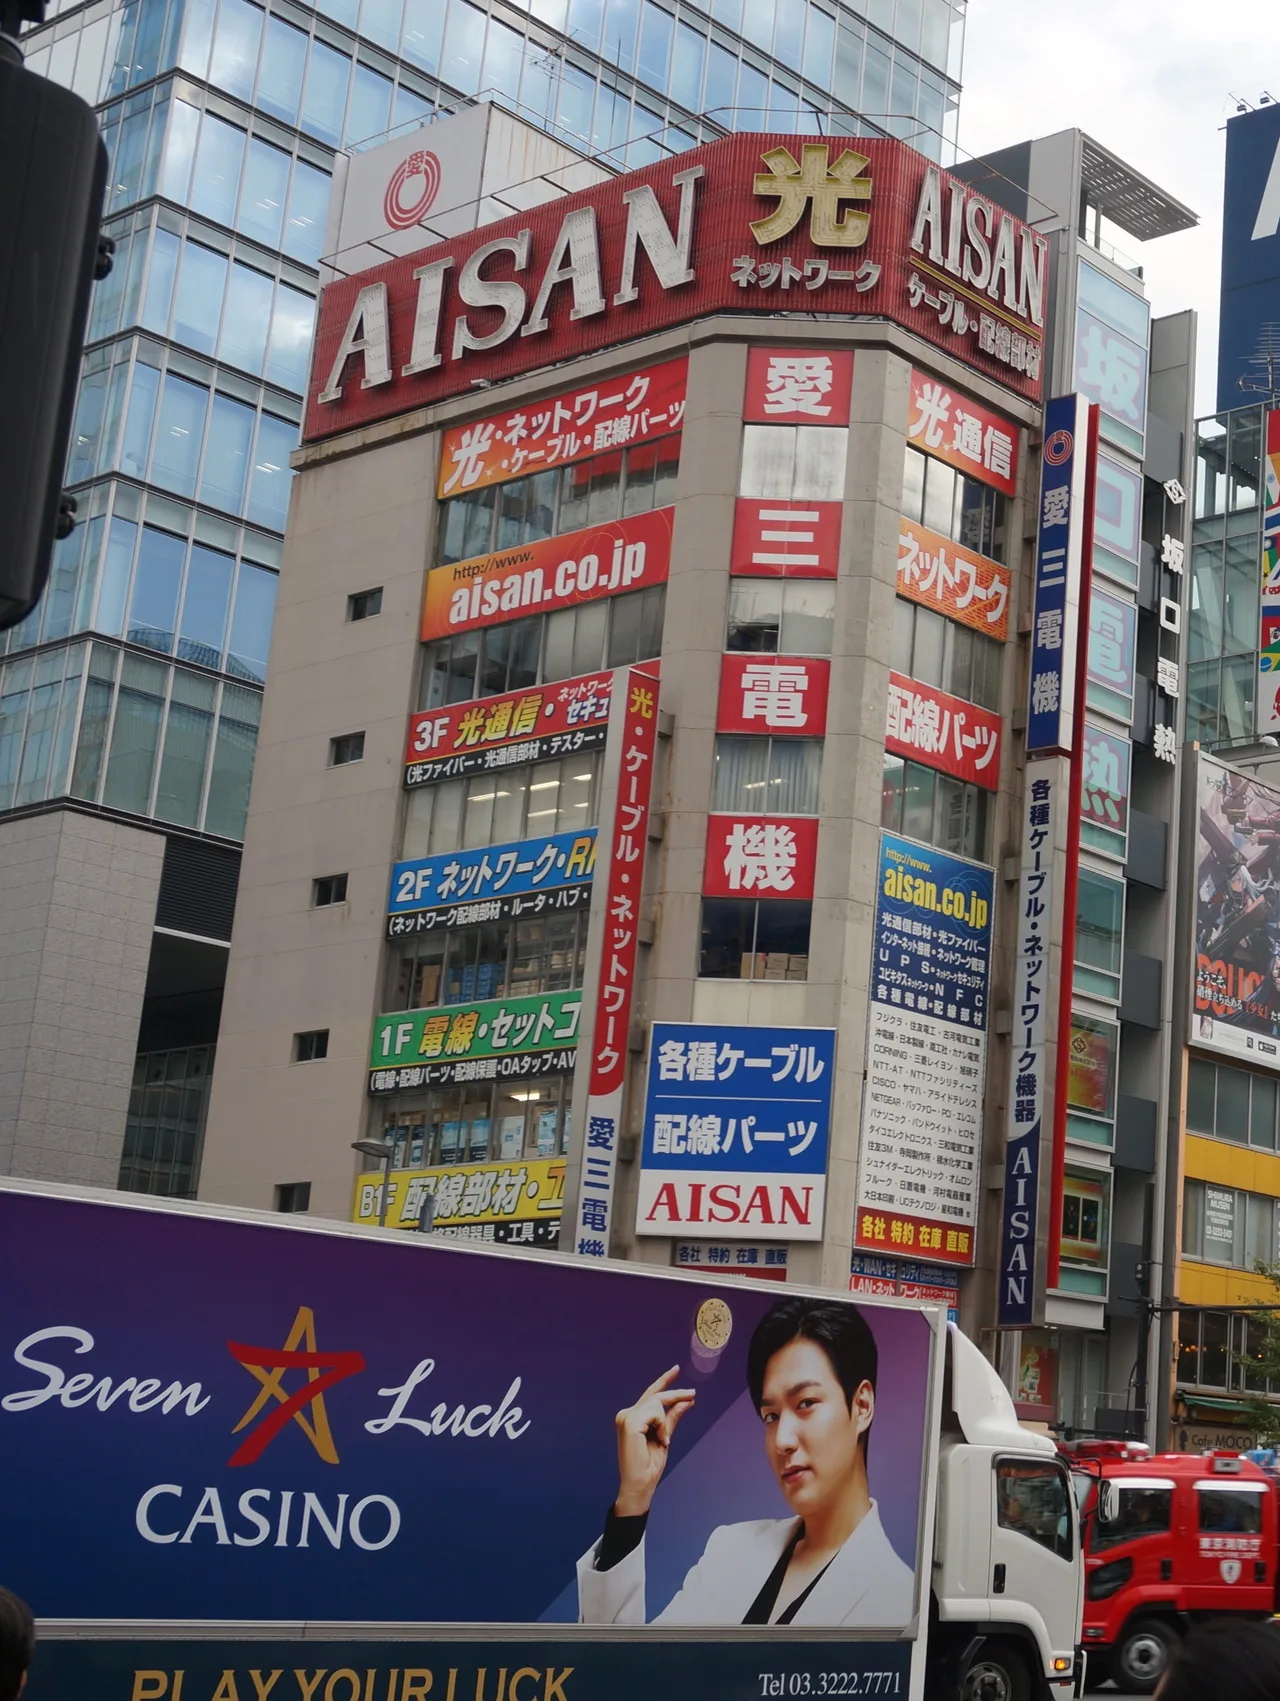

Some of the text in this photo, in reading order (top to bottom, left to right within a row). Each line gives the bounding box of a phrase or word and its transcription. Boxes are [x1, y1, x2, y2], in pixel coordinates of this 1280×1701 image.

[749, 143, 873, 248] 光
[731, 255, 882, 292] ネットワーク
[910, 166, 1049, 329] AISAN
[317, 166, 705, 405] AISAN
[444, 423, 495, 494] 光
[909, 383, 1013, 480] 光通信
[449, 539, 646, 624] aisan.co.jp
[453, 551, 535, 581] http://www.
[896, 532, 1008, 622] ネットワーク
[1032, 485, 1069, 714] 愛三電機
[1153, 532, 1184, 765] 坂口電熱
[414, 717, 449, 751] 3F
[885, 684, 998, 770] 配線パーツ
[396, 868, 432, 903] 2F
[884, 866, 988, 929] aisan.co.jp
[1014, 779, 1051, 1123] 各種ケーブル・ネットワーク機器
[380, 1022, 413, 1056] 1F
[658, 1040, 825, 1084] 各種ケーブル
[651, 1114, 818, 1157] 配線パーツ
[645, 1183, 814, 1225] AISAN
[862, 1214, 970, 1254] 各社 特約 在庫 直販
[1007, 1147, 1033, 1305] AISAN
[679, 1246, 701, 1263] 各社
[736, 1248, 758, 1265] 在庫
[2, 1325, 212, 1417] Seven
[364, 1358, 532, 1440] Luck
[1214, 1434, 1253, 1449] MOCO
[135, 1484, 402, 1551] CASINO
[758, 1671, 901, 1697] Tel 03.3222.7771
